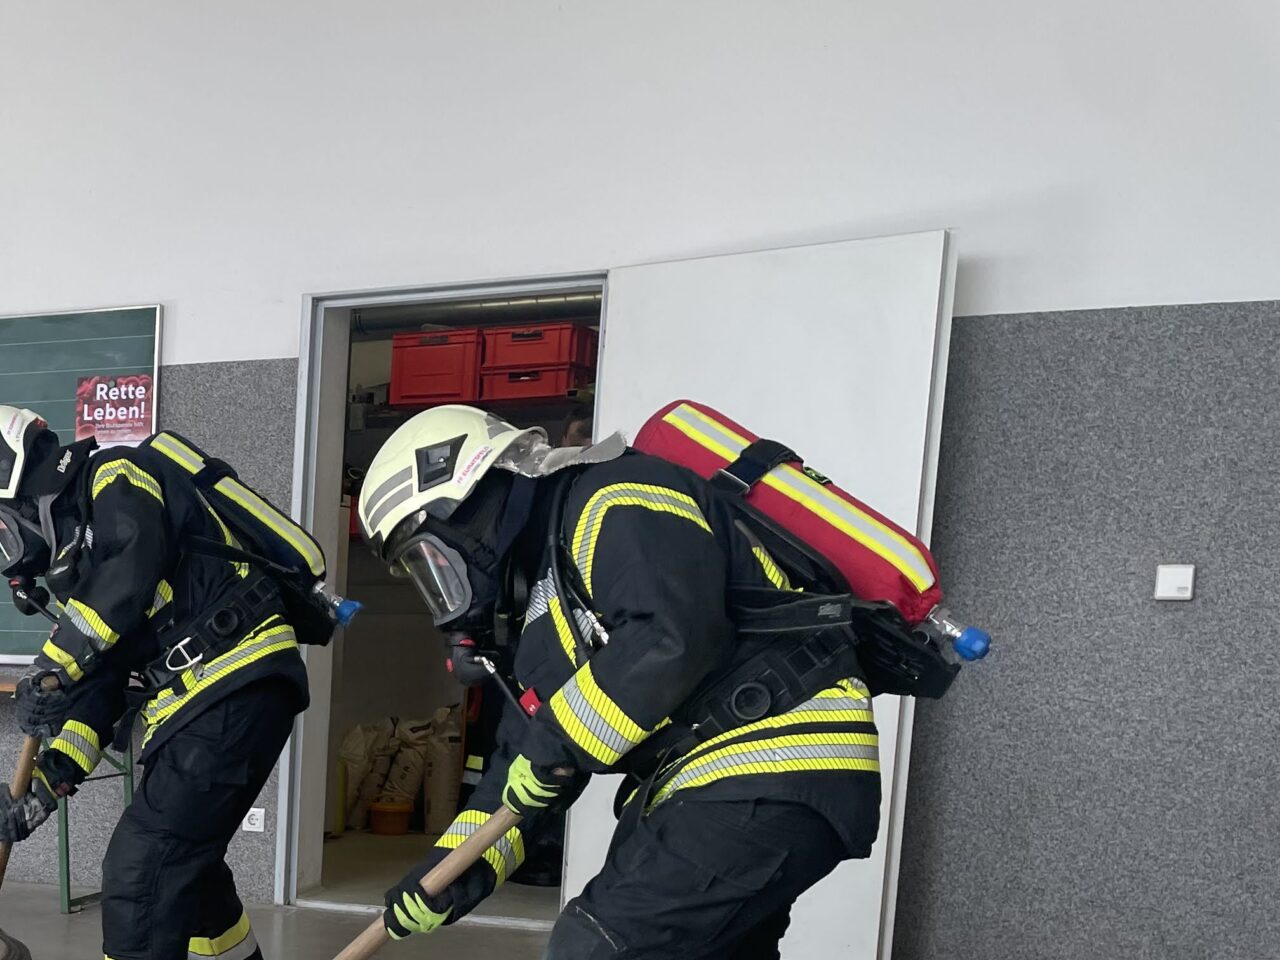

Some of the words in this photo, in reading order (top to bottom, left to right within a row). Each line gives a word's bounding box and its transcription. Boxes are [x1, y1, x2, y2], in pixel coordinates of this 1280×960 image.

[96, 383, 146, 400] Rette
[83, 402, 145, 420] Leben!
[57, 449, 73, 473] Dräger
